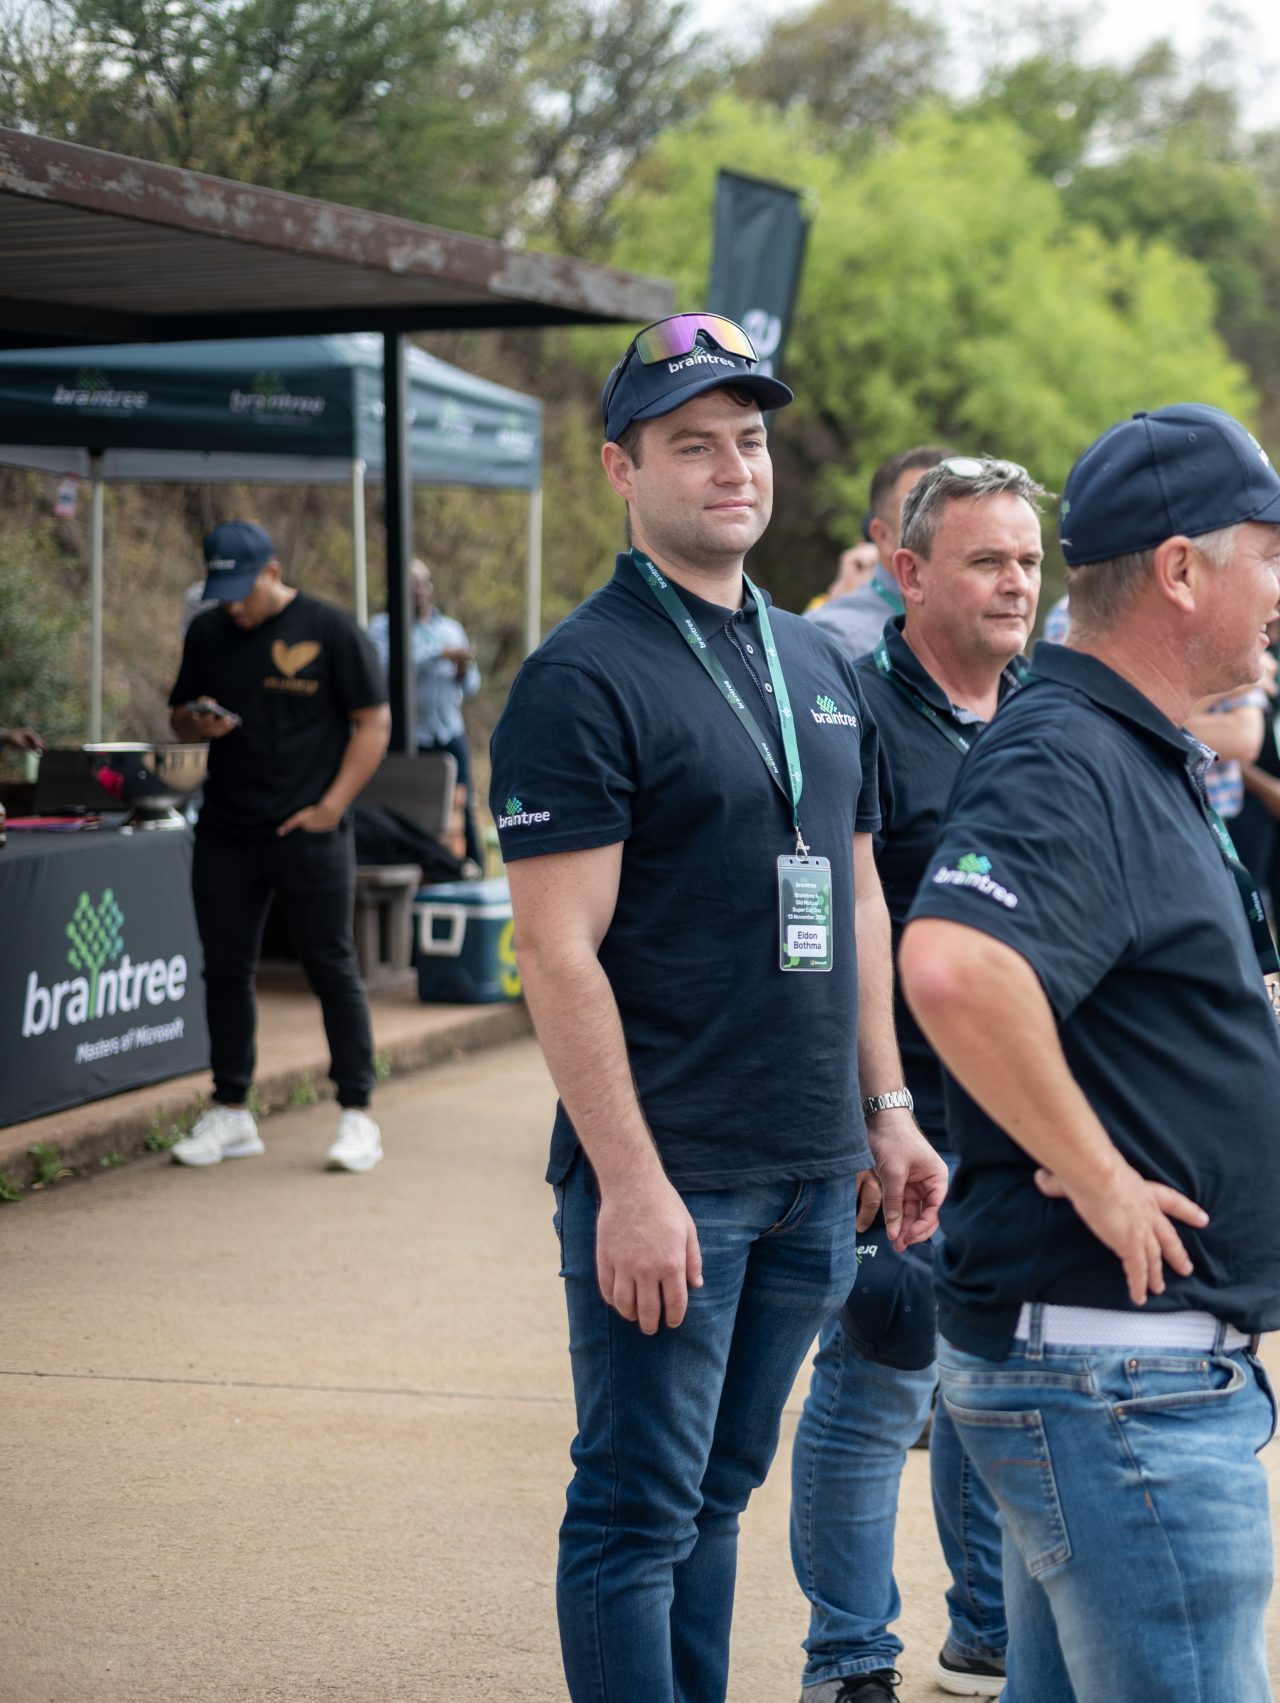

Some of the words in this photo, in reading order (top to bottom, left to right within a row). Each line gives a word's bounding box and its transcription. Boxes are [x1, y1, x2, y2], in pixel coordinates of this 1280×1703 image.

[668, 353, 736, 374] braintree
[811, 708, 857, 728] braintree
[499, 811, 551, 829] braintree
[933, 866, 1018, 909] braintree
[793, 941, 822, 950] Bothma
[797, 931, 818, 940] Eldon
[22, 954, 187, 1038] braintree
[75, 1038, 120, 1064] Masters
[134, 1016, 184, 1048] Microsoft
